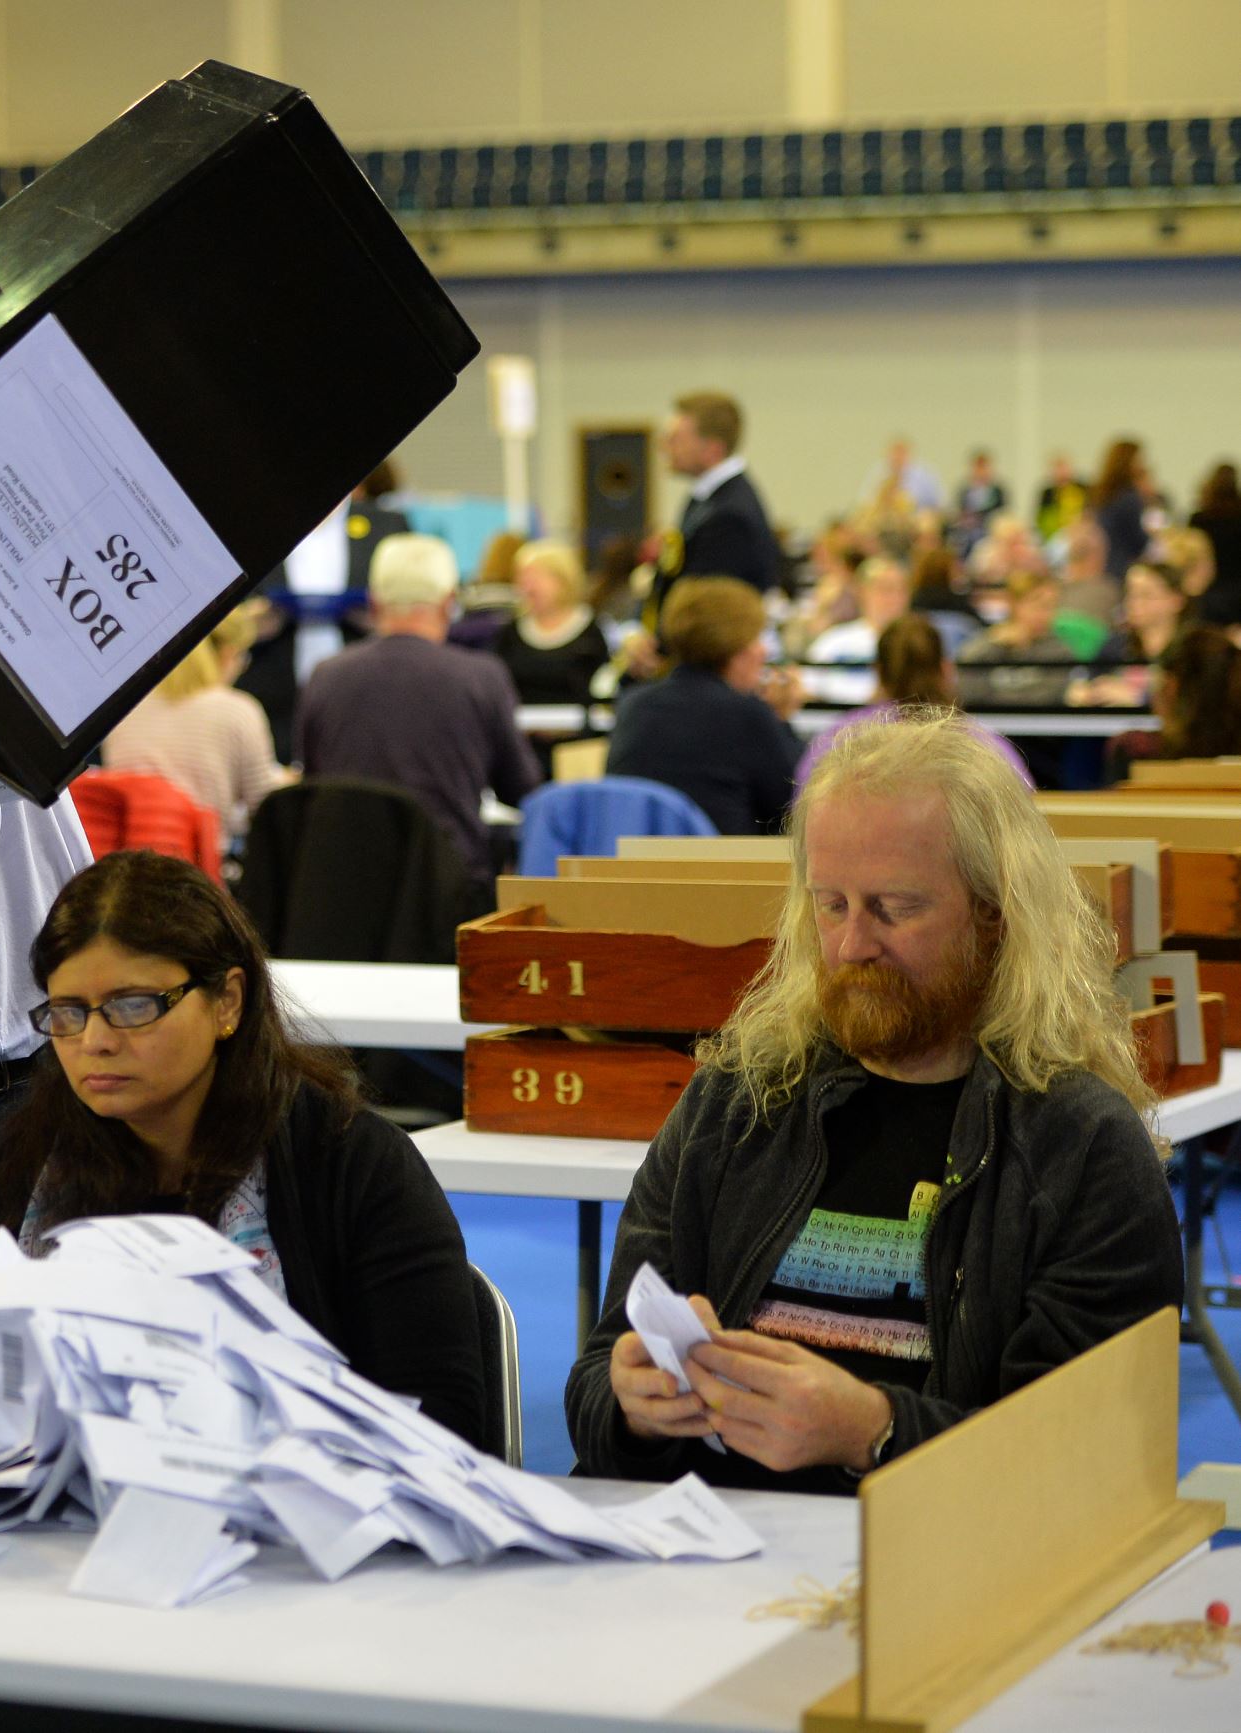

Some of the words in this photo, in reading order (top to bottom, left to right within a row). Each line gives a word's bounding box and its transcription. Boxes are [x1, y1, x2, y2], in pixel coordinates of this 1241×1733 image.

[3, 465, 20, 485] Road
[18, 483, 48, 520] Langlands
[20, 505, 35, 523] Park
[10, 510, 41, 549] POLLING
[34, 523, 49, 541] Pirie
[1, 569, 15, 586] June
[95, 534, 158, 600] 285
[44, 556, 125, 654] BOX
[9, 607, 33, 637] Glasgow
[6, 634, 16, 645] UK
[518, 960, 584, 996] 41
[512, 1068, 584, 1105] 39
[917, 1191, 923, 1200] B
